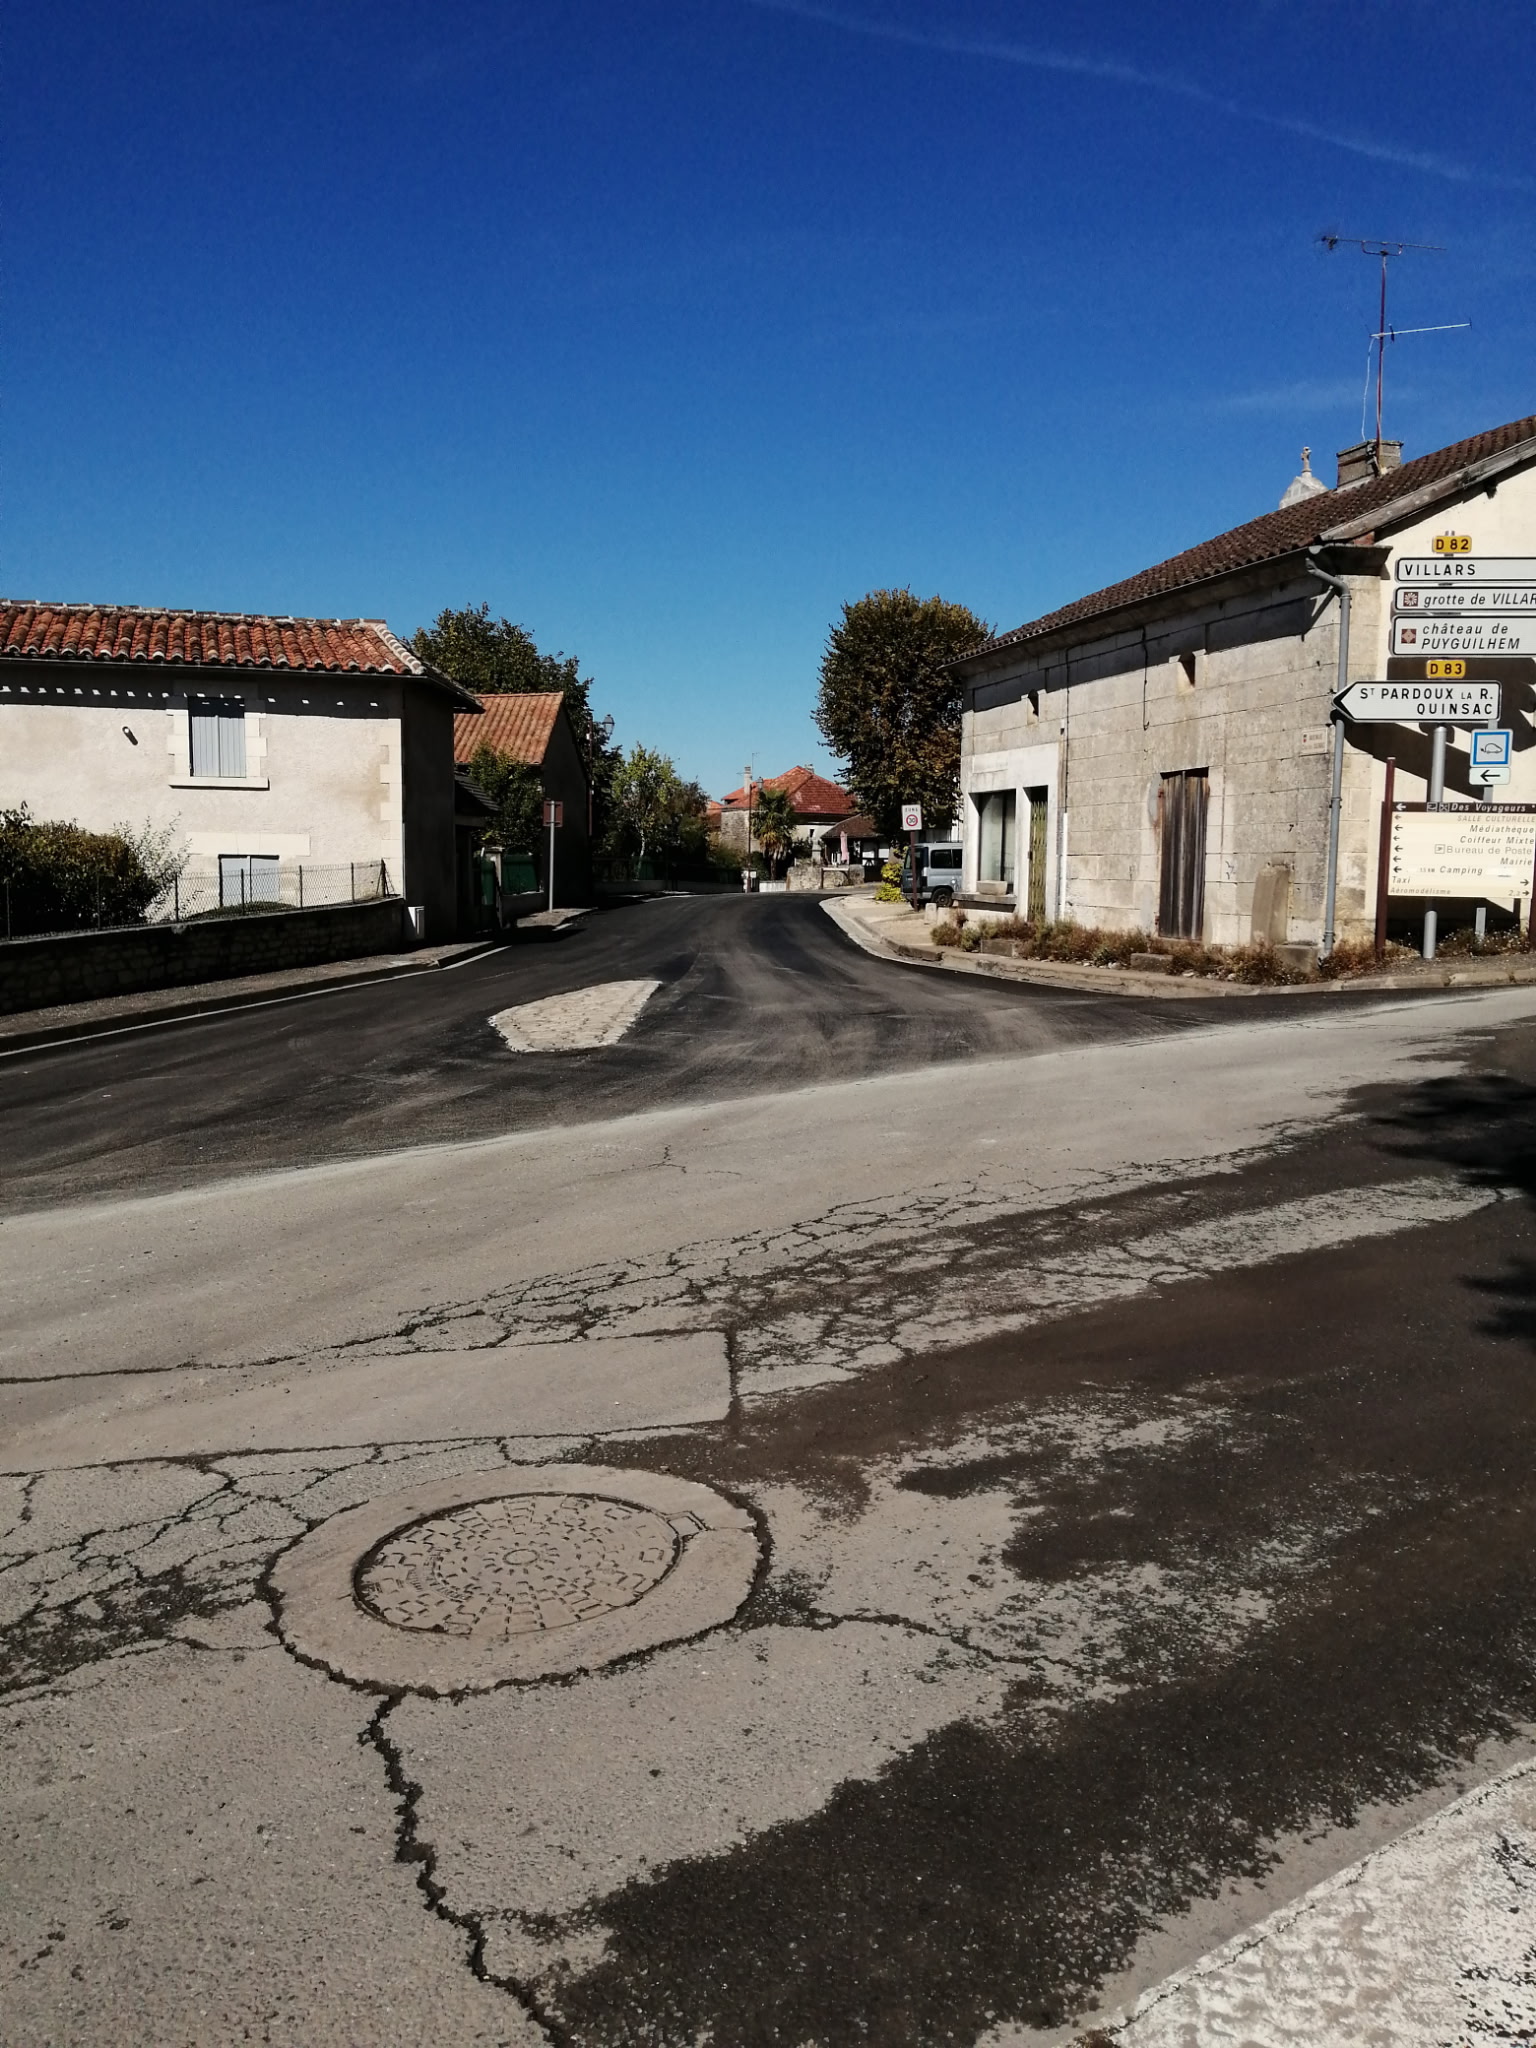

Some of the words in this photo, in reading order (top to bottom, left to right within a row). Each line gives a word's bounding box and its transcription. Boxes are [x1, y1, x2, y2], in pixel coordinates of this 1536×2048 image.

[1436, 538, 1444, 549] D
[1450, 538, 1469, 549] 82
[1405, 564, 1476, 576] VILLARS
[1424, 595, 1465, 607] grotte
[1471, 594, 1486, 604] de
[1423, 624, 1483, 635] château
[1492, 622, 1508, 634] de
[1421, 638, 1520, 650] PUYGUILHEM
[1430, 663, 1438, 675] D
[1444, 663, 1463, 675] 83
[1381, 688, 1454, 700] PARDOUX
[1461, 692, 1472, 700] LA
[1480, 688, 1493, 700] R.
[1417, 703, 1493, 715] QUINSAC
[1475, 804, 1526, 813] Voyageurs
[1485, 815, 1535, 823] CULTURELLE
[1460, 836, 1501, 844] Coiffeur
[1506, 836, 1534, 845] Mixte
[1446, 846, 1484, 854] Bureau
[1488, 847, 1501, 855] de
[1505, 847, 1532, 855] Poste
[1500, 857, 1532, 866] Mairie
[1440, 866, 1483, 876] Camping
[1392, 876, 1411, 884] Taxi
